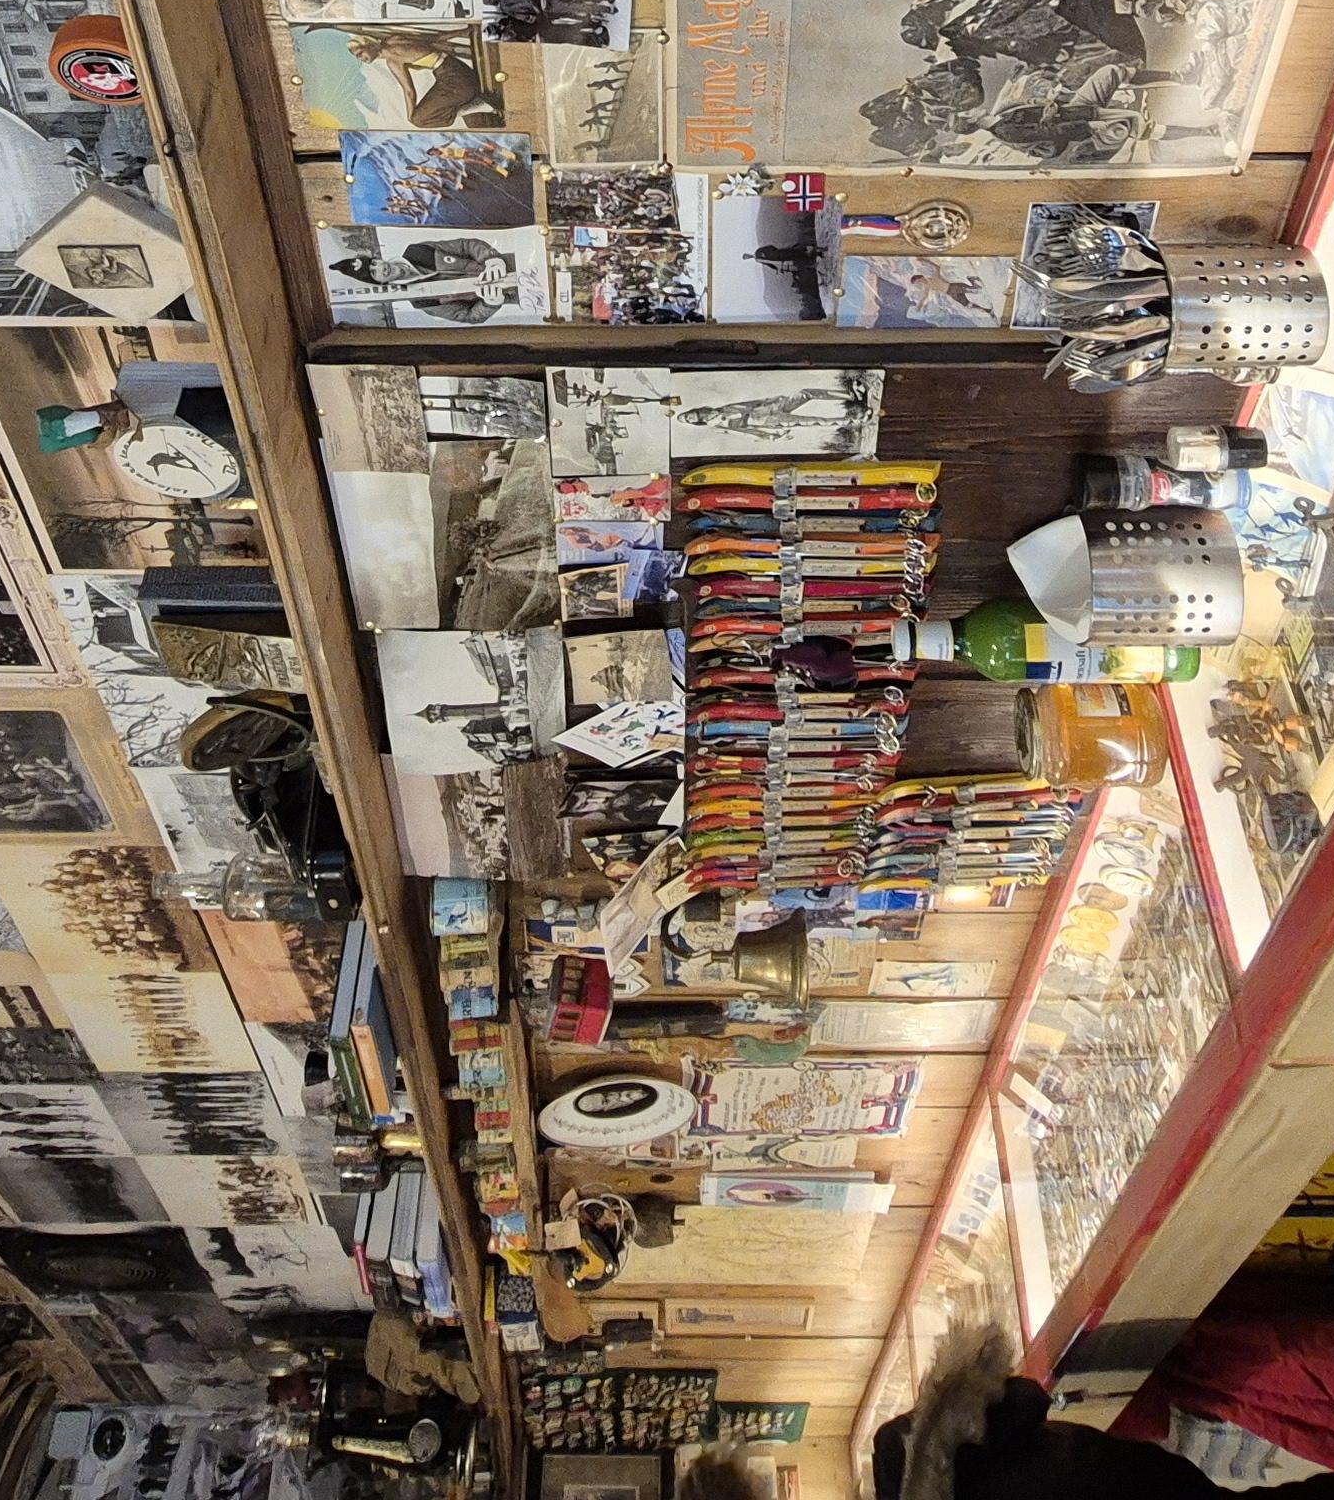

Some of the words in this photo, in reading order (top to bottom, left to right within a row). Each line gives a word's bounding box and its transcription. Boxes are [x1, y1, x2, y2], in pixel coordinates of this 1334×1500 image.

[746, 9, 770, 38] ihr
[745, 61, 768, 98] und
[684, 57, 755, 161] Alpine
